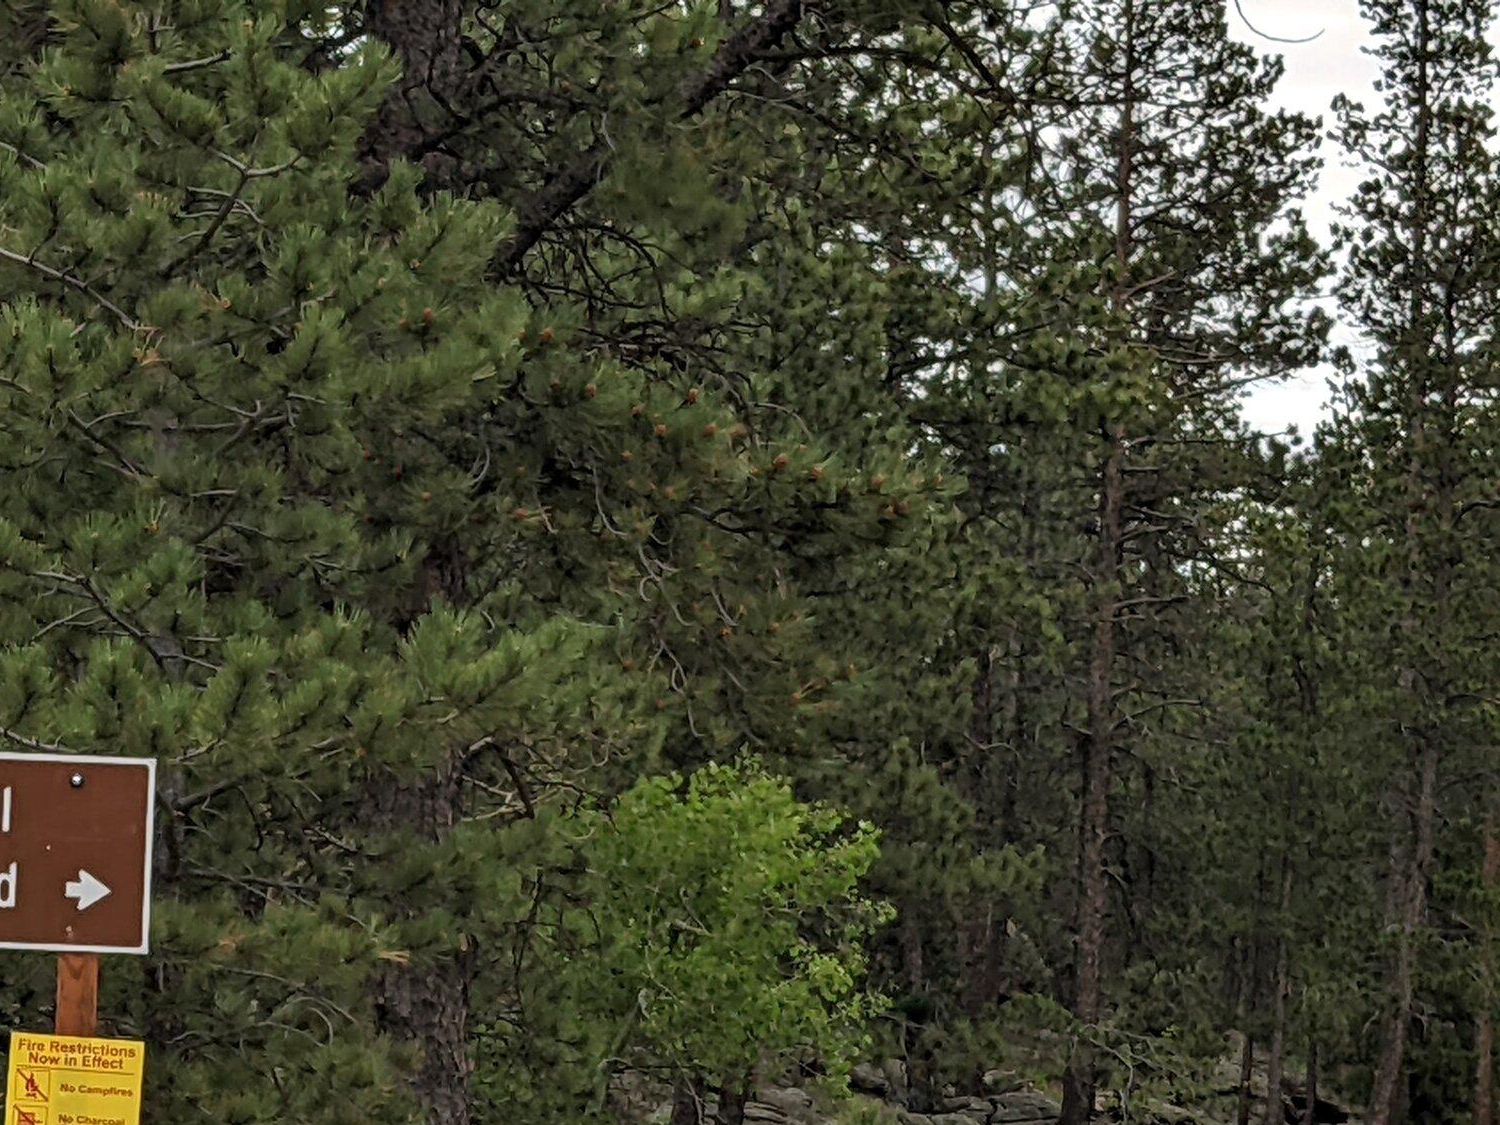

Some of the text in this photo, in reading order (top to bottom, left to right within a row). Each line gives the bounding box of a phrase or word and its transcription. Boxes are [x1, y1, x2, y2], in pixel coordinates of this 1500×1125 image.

[18, 1038, 136, 1058] Fire Restrictions
[28, 1052, 123, 1070] Now in Effect
[59, 1083, 133, 1098] No Campfires
[58, 1114, 74, 1124] No
